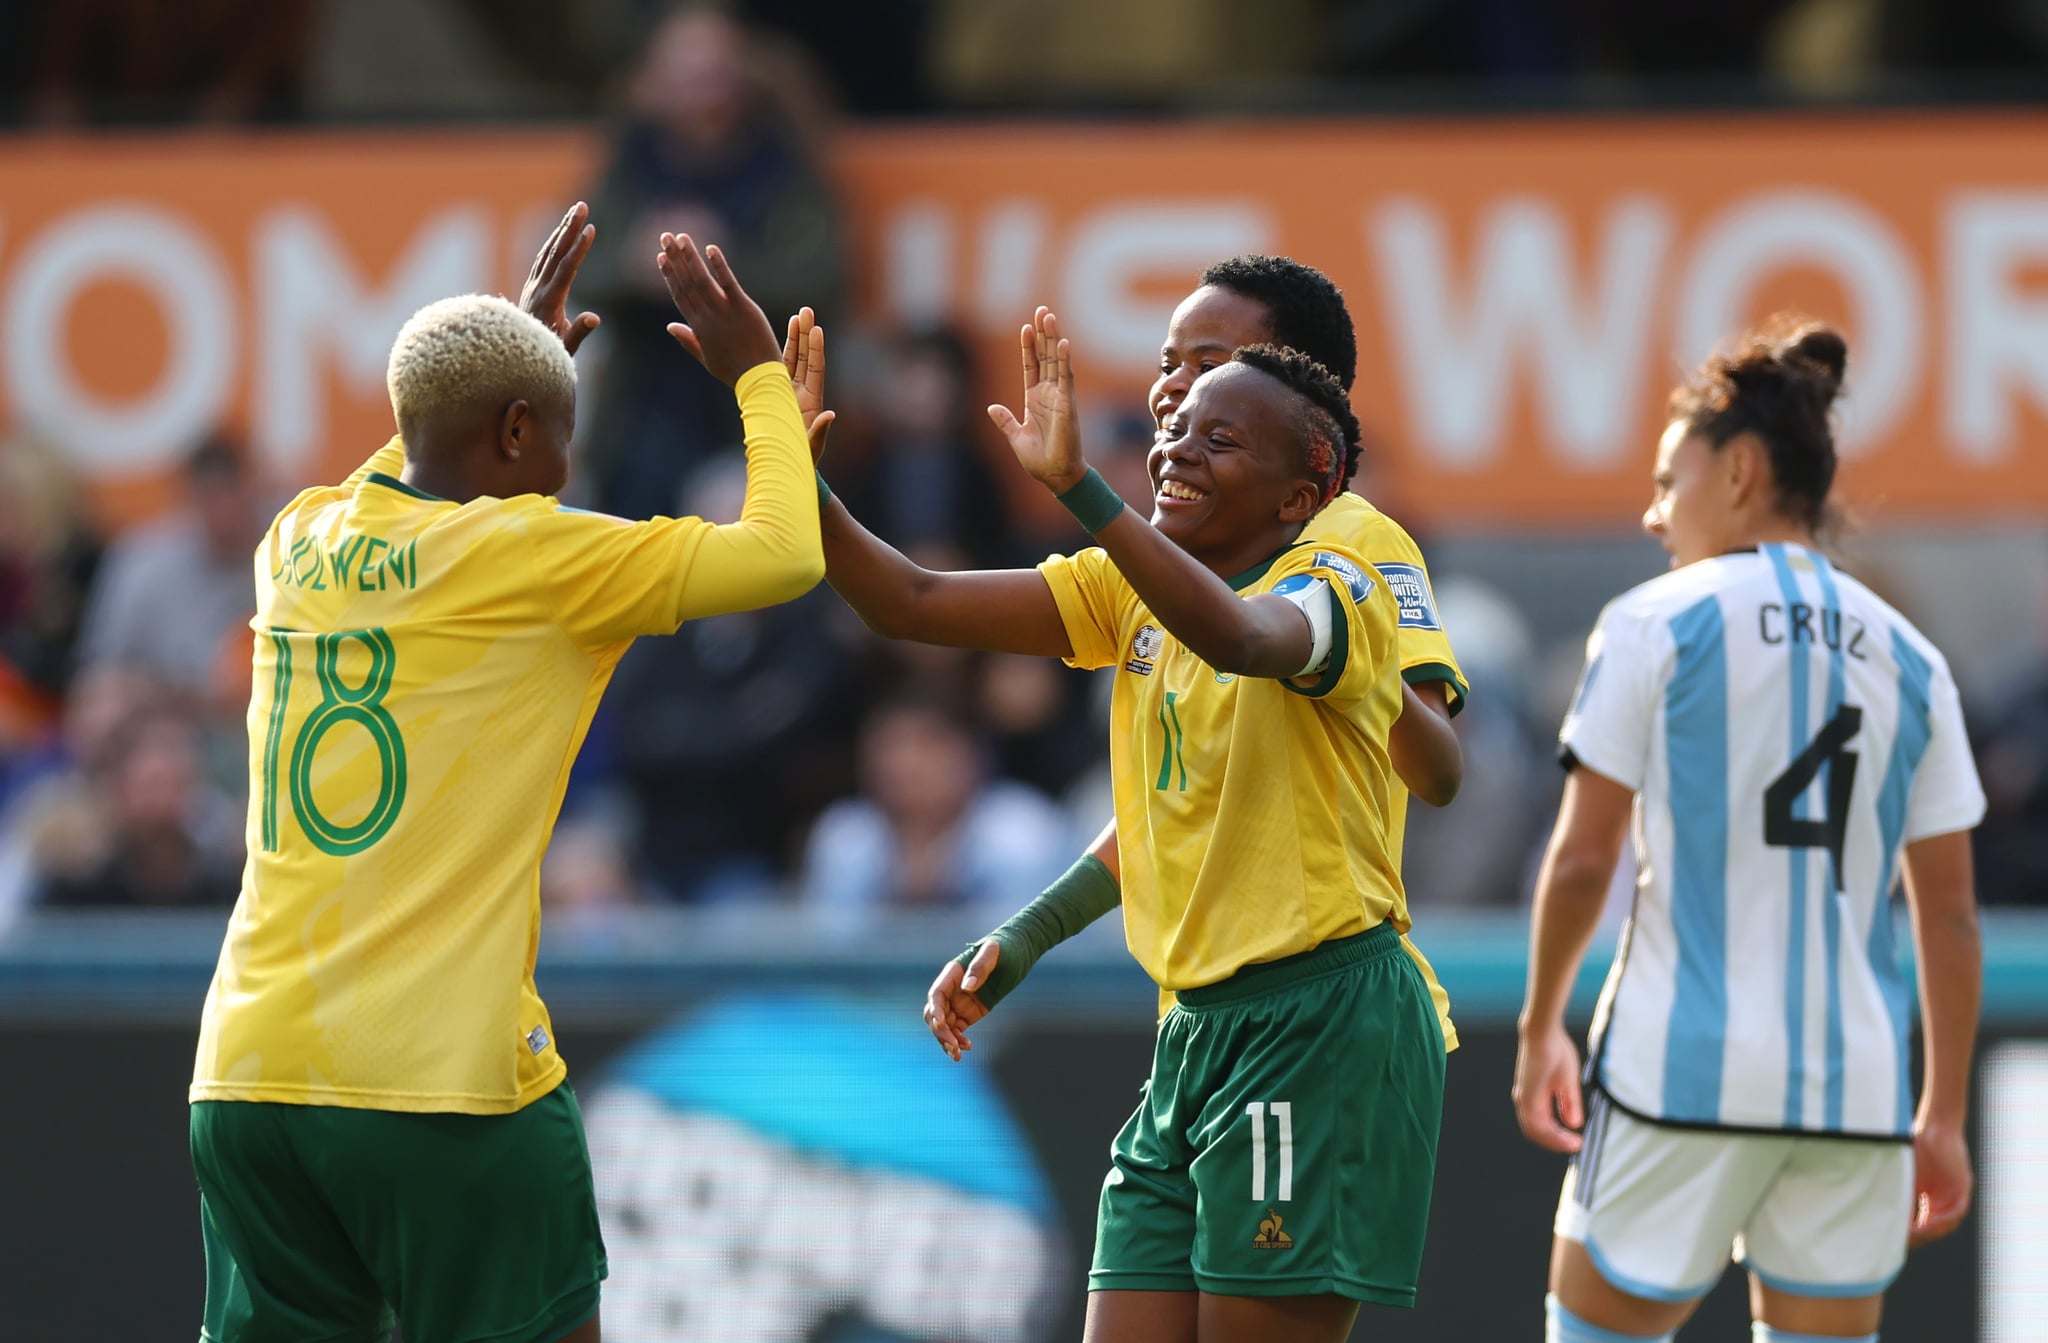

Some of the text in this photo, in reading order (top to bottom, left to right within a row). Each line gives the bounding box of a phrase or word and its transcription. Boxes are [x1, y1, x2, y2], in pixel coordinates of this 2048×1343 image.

[1384, 574, 1419, 584] FOOTBALL
[1759, 603, 1867, 660] CRUZ
[262, 626, 408, 857] 18
[1156, 692, 1187, 791] 11
[1763, 704, 1862, 893] 4
[1245, 1101, 1293, 1201] 11
